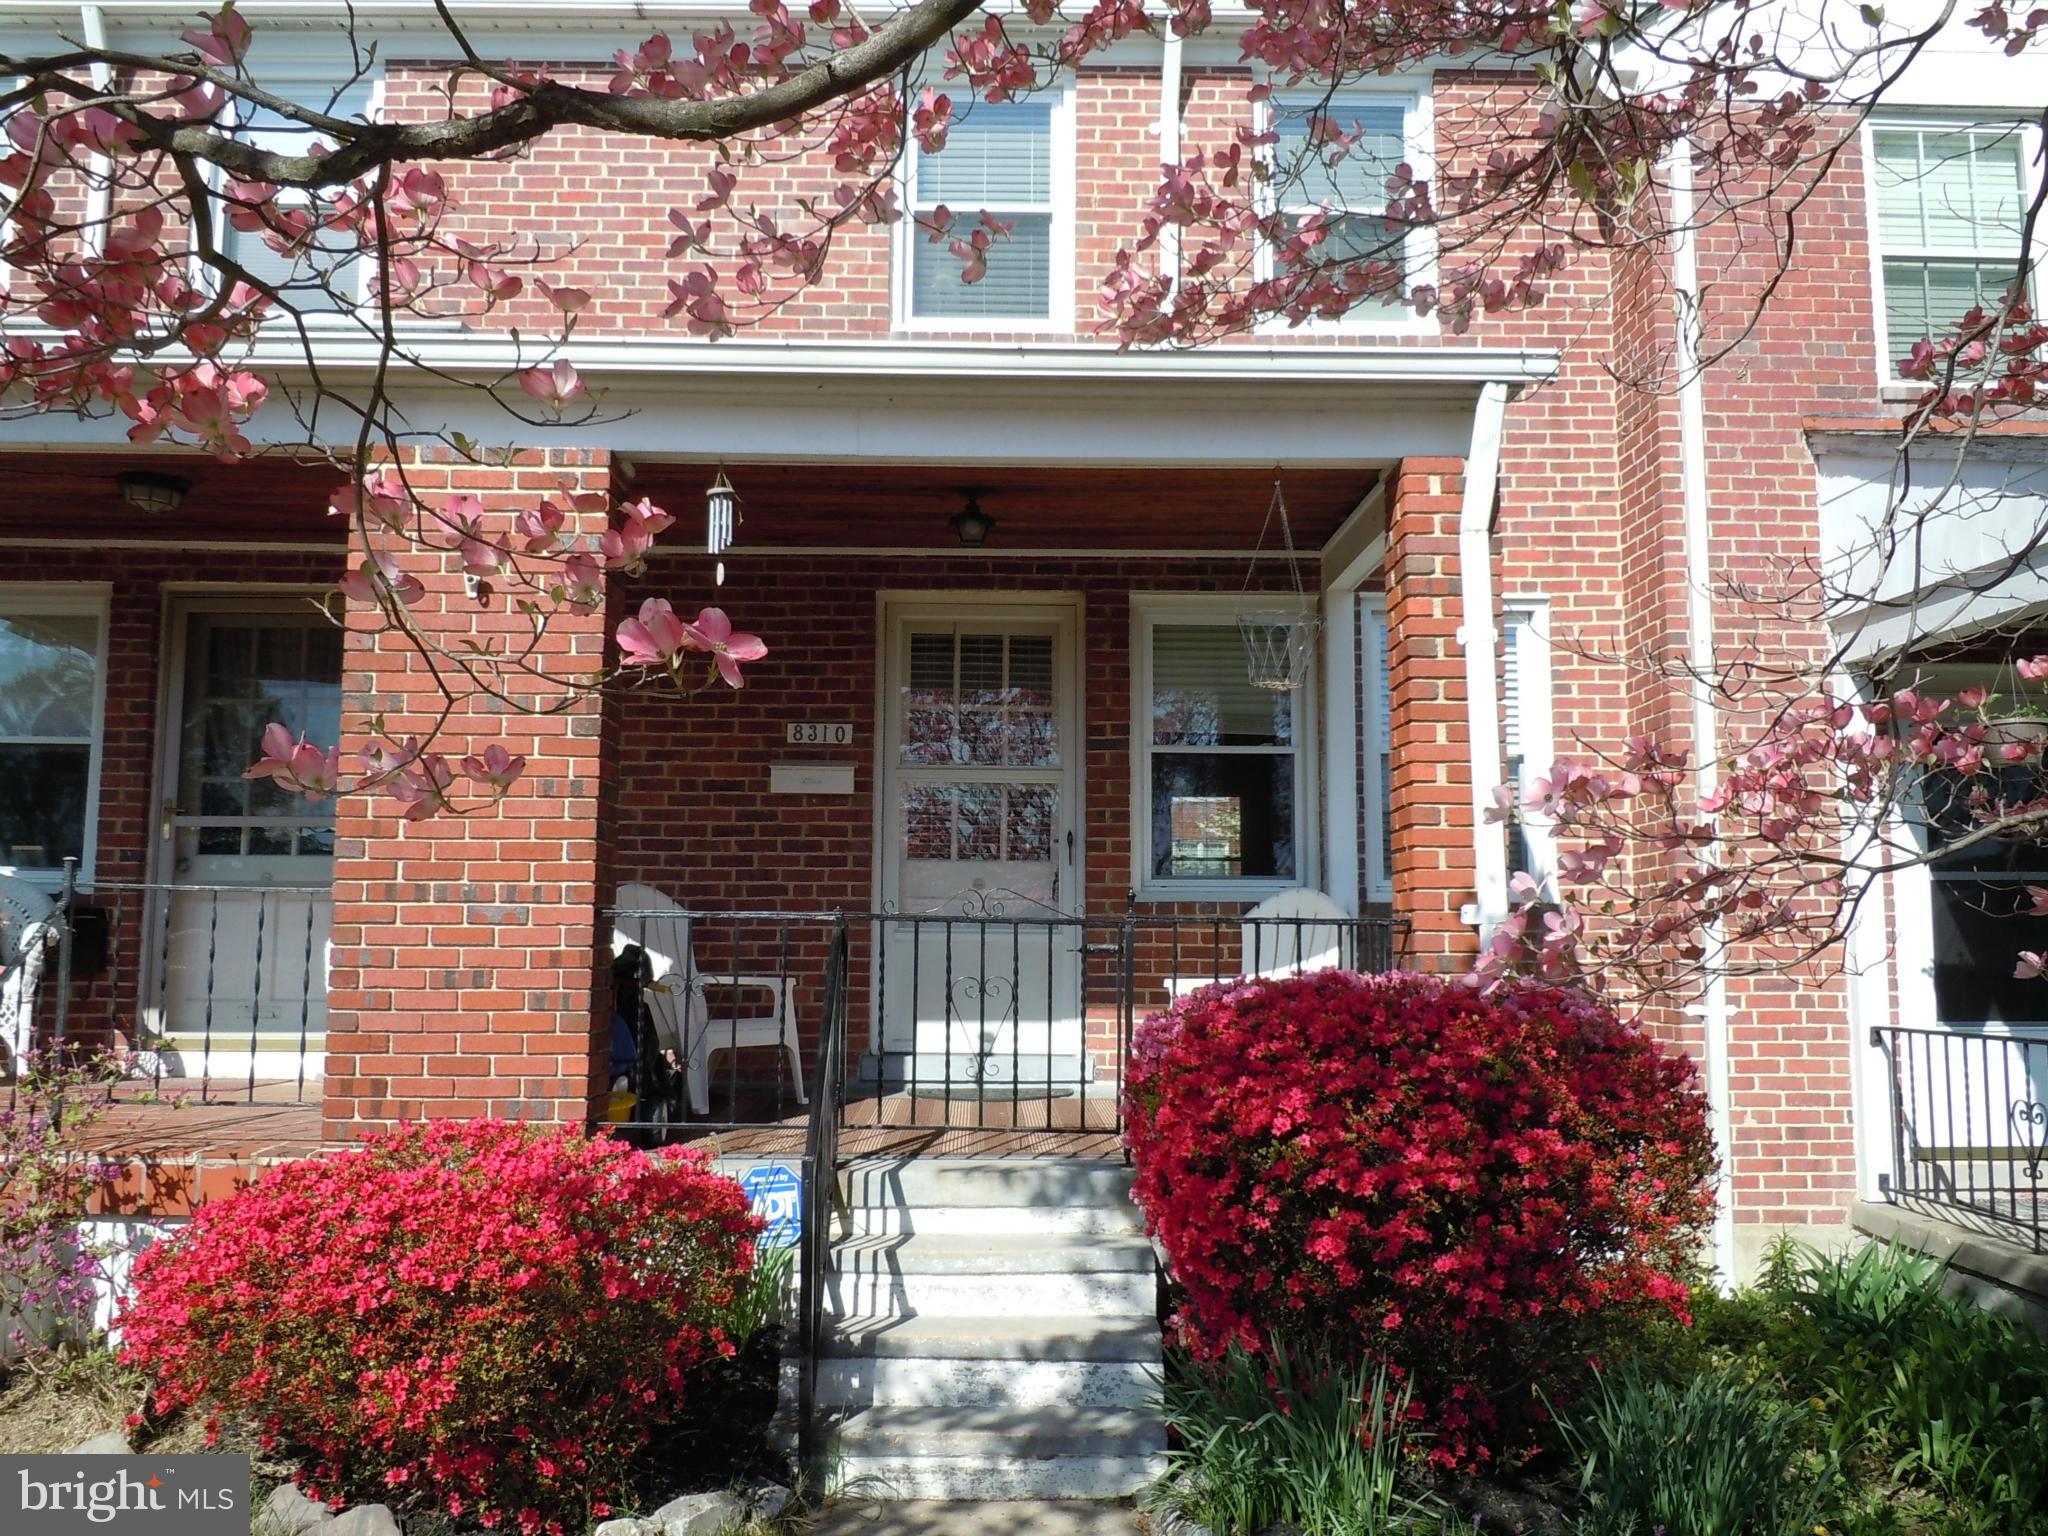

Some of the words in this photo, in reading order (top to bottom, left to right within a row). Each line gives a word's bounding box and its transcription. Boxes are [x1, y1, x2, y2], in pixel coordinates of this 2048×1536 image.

[792, 724, 846, 743] 8310
[750, 1175, 779, 1184] Secued
[779, 1173, 789, 1182] by
